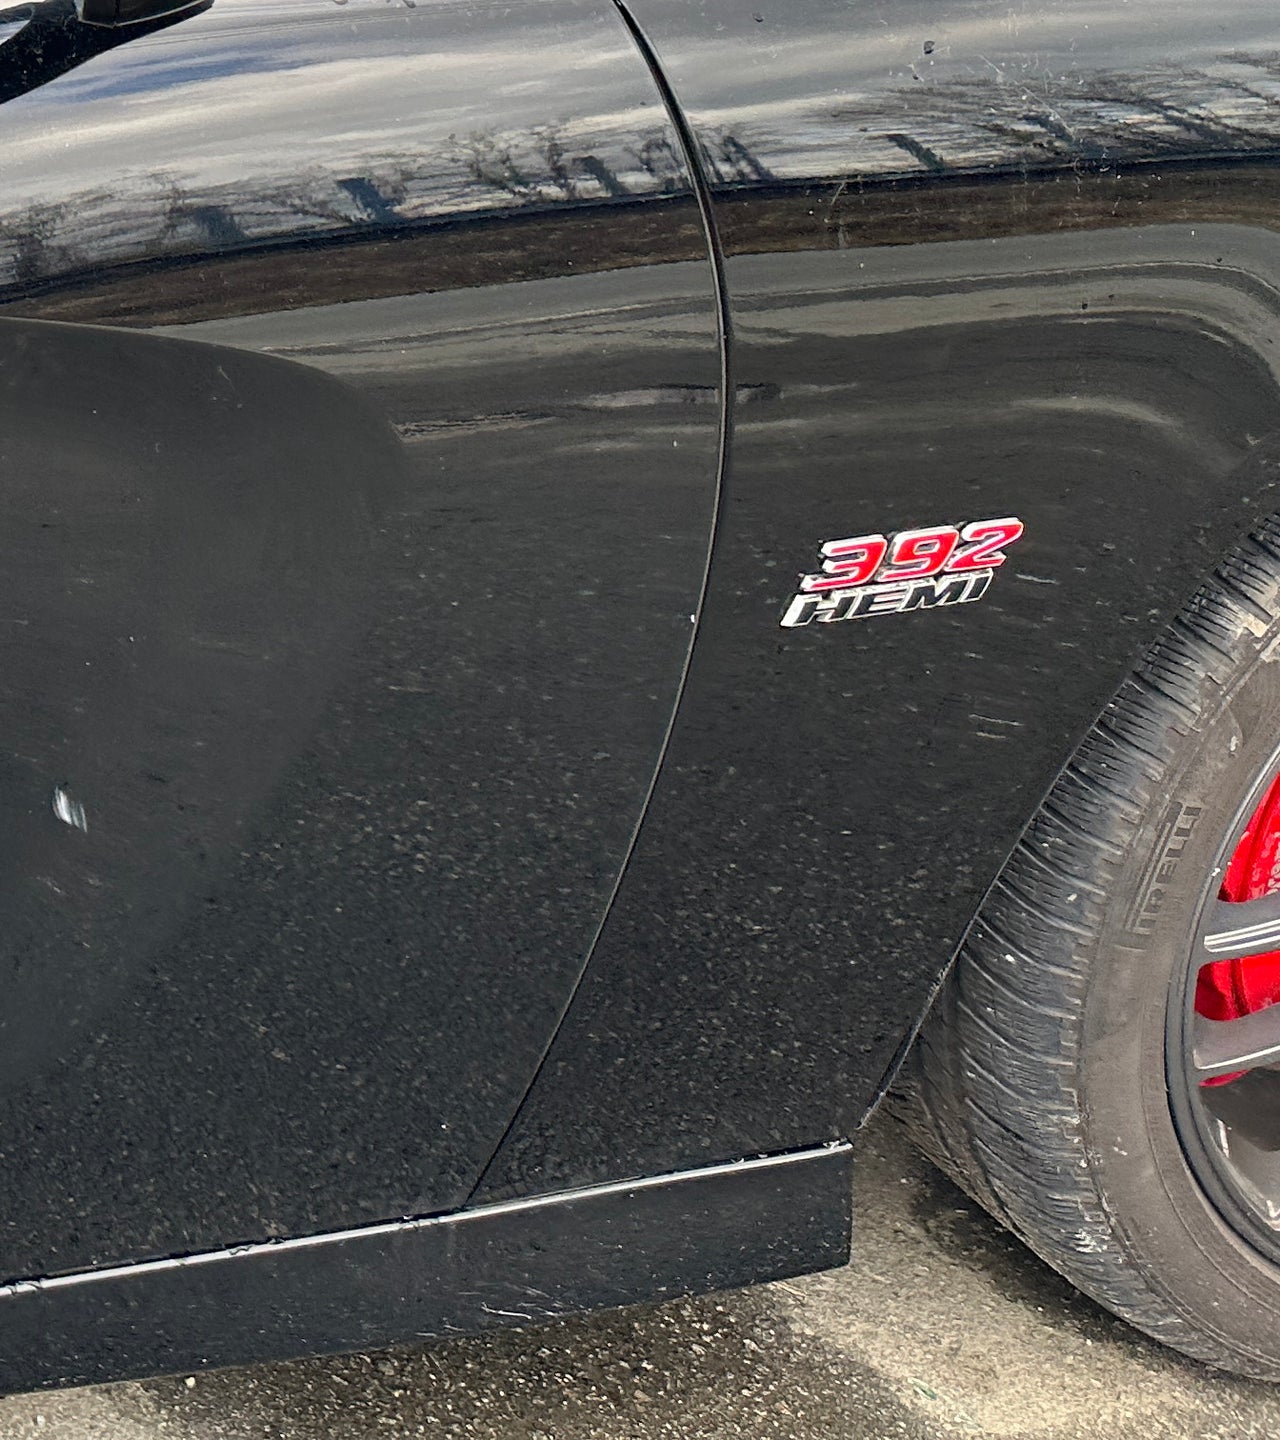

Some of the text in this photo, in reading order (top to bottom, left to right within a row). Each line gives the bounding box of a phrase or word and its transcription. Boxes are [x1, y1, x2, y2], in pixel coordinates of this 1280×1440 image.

[799, 517, 1025, 592] 392
[779, 568, 995, 628] HEMI
[1125, 801, 1202, 935] PIRELLI
